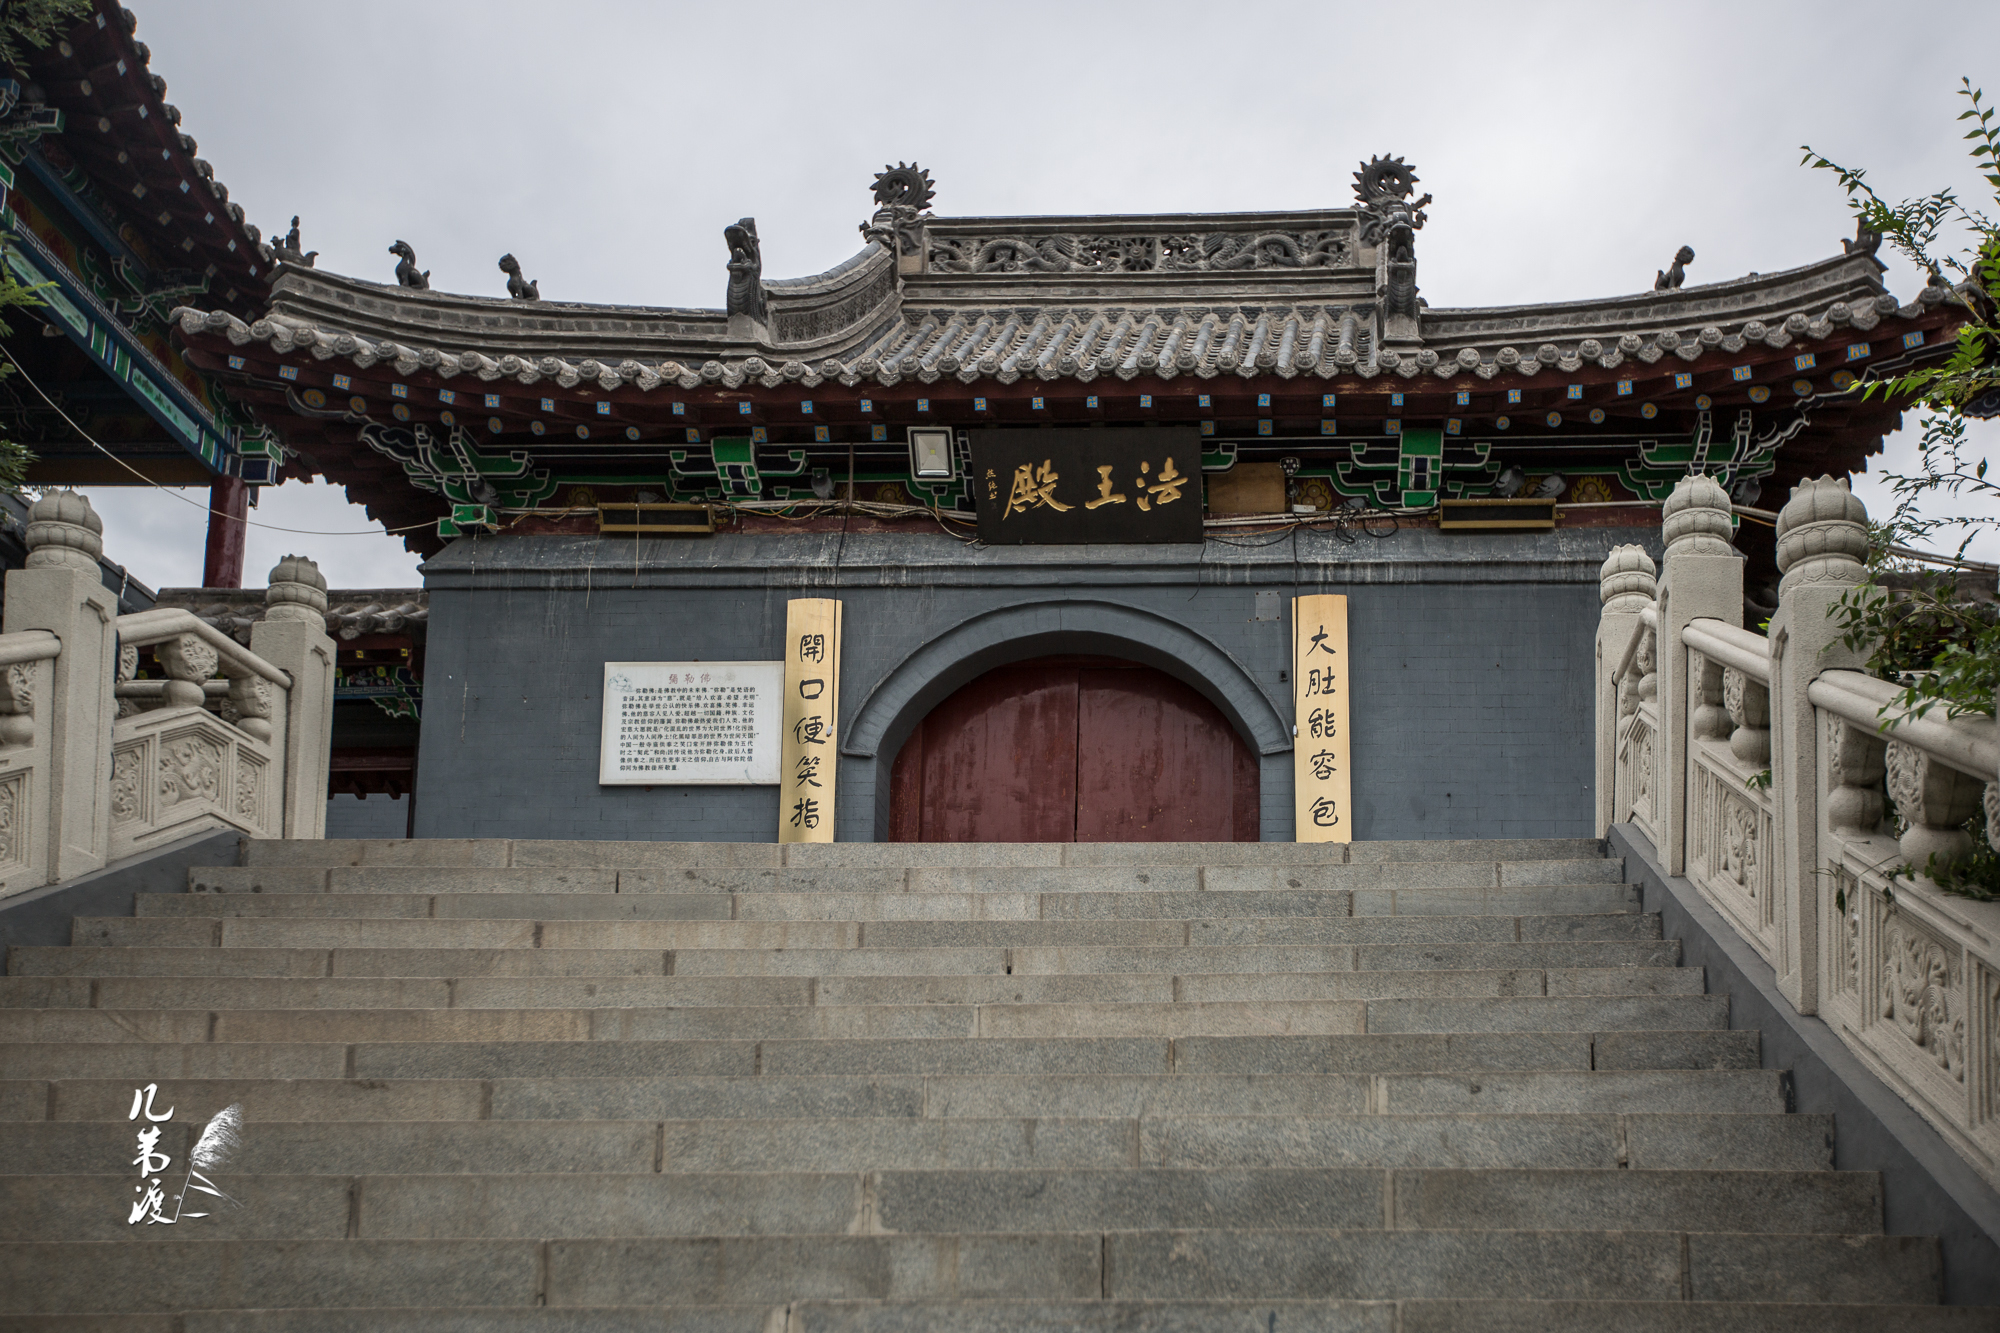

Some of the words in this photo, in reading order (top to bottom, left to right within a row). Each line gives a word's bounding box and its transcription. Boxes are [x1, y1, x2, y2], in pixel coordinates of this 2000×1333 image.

[1002, 456, 1189, 521] 法王殿
[790, 633, 826, 830] 開口便笑指
[1305, 625, 1339, 843] 大肚能容包
